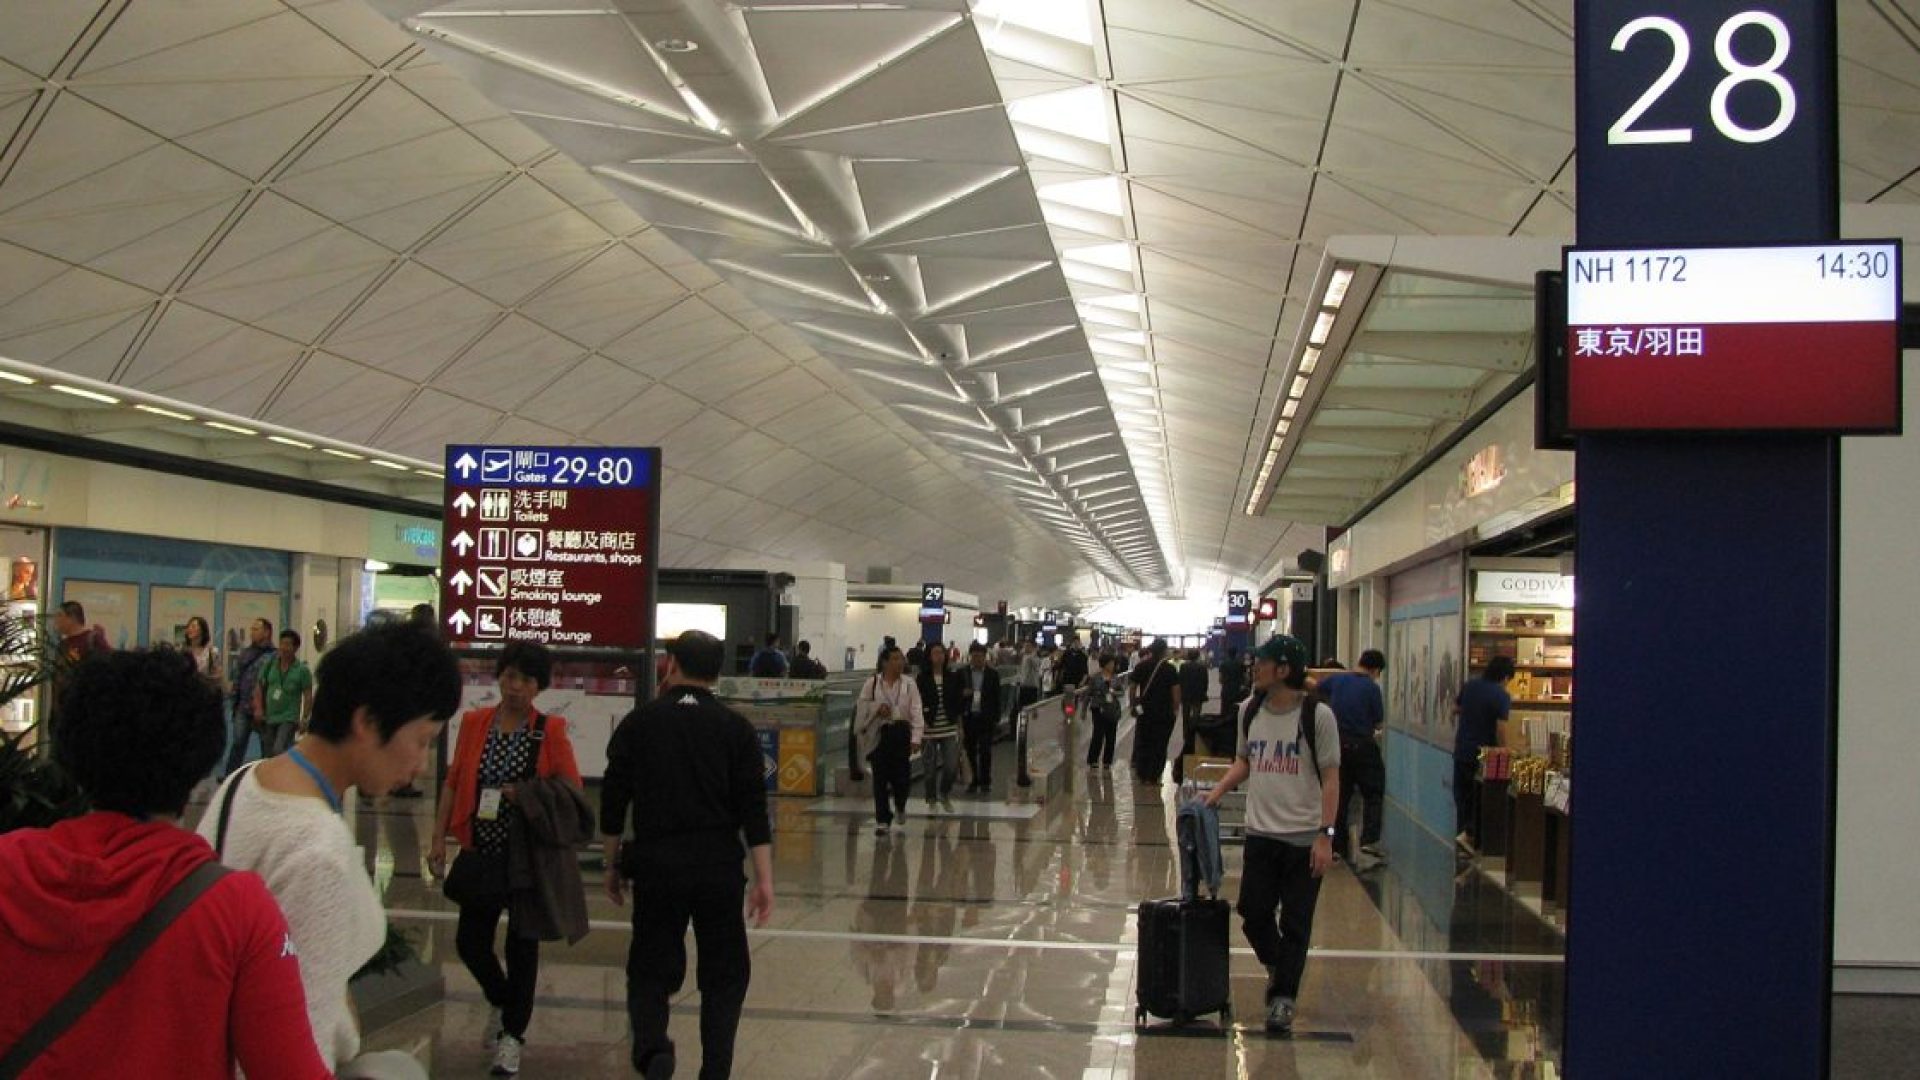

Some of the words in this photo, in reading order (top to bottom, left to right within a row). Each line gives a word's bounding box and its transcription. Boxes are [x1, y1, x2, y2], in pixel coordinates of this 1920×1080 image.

[1606, 10, 1797, 145] 28
[1574, 257, 1614, 283] NH
[1625, 255, 1687, 282] 1172
[1815, 251, 1889, 280] 14:30
[1574, 327, 1703, 357] 東京/羽田
[515, 450, 549, 469] 閘口
[514, 470, 548, 483] Gates
[551, 456, 633, 484] 29-80
[513, 489, 568, 509] 洗手間
[513, 510, 549, 522] Toilets
[546, 529, 637, 550] 餐廳及商店
[544, 549, 608, 564] Restaurants,
[610, 551, 642, 566] shops
[510, 568, 564, 588] 吸煙室
[1500, 577, 1567, 591] GODIVA
[510, 587, 560, 604] Smoking
[561, 588, 603, 605] lounge
[925, 587, 942, 601] 29
[1230, 594, 1246, 608] 30
[508, 627, 550, 643] Resting
[551, 628, 593, 643] lounge
